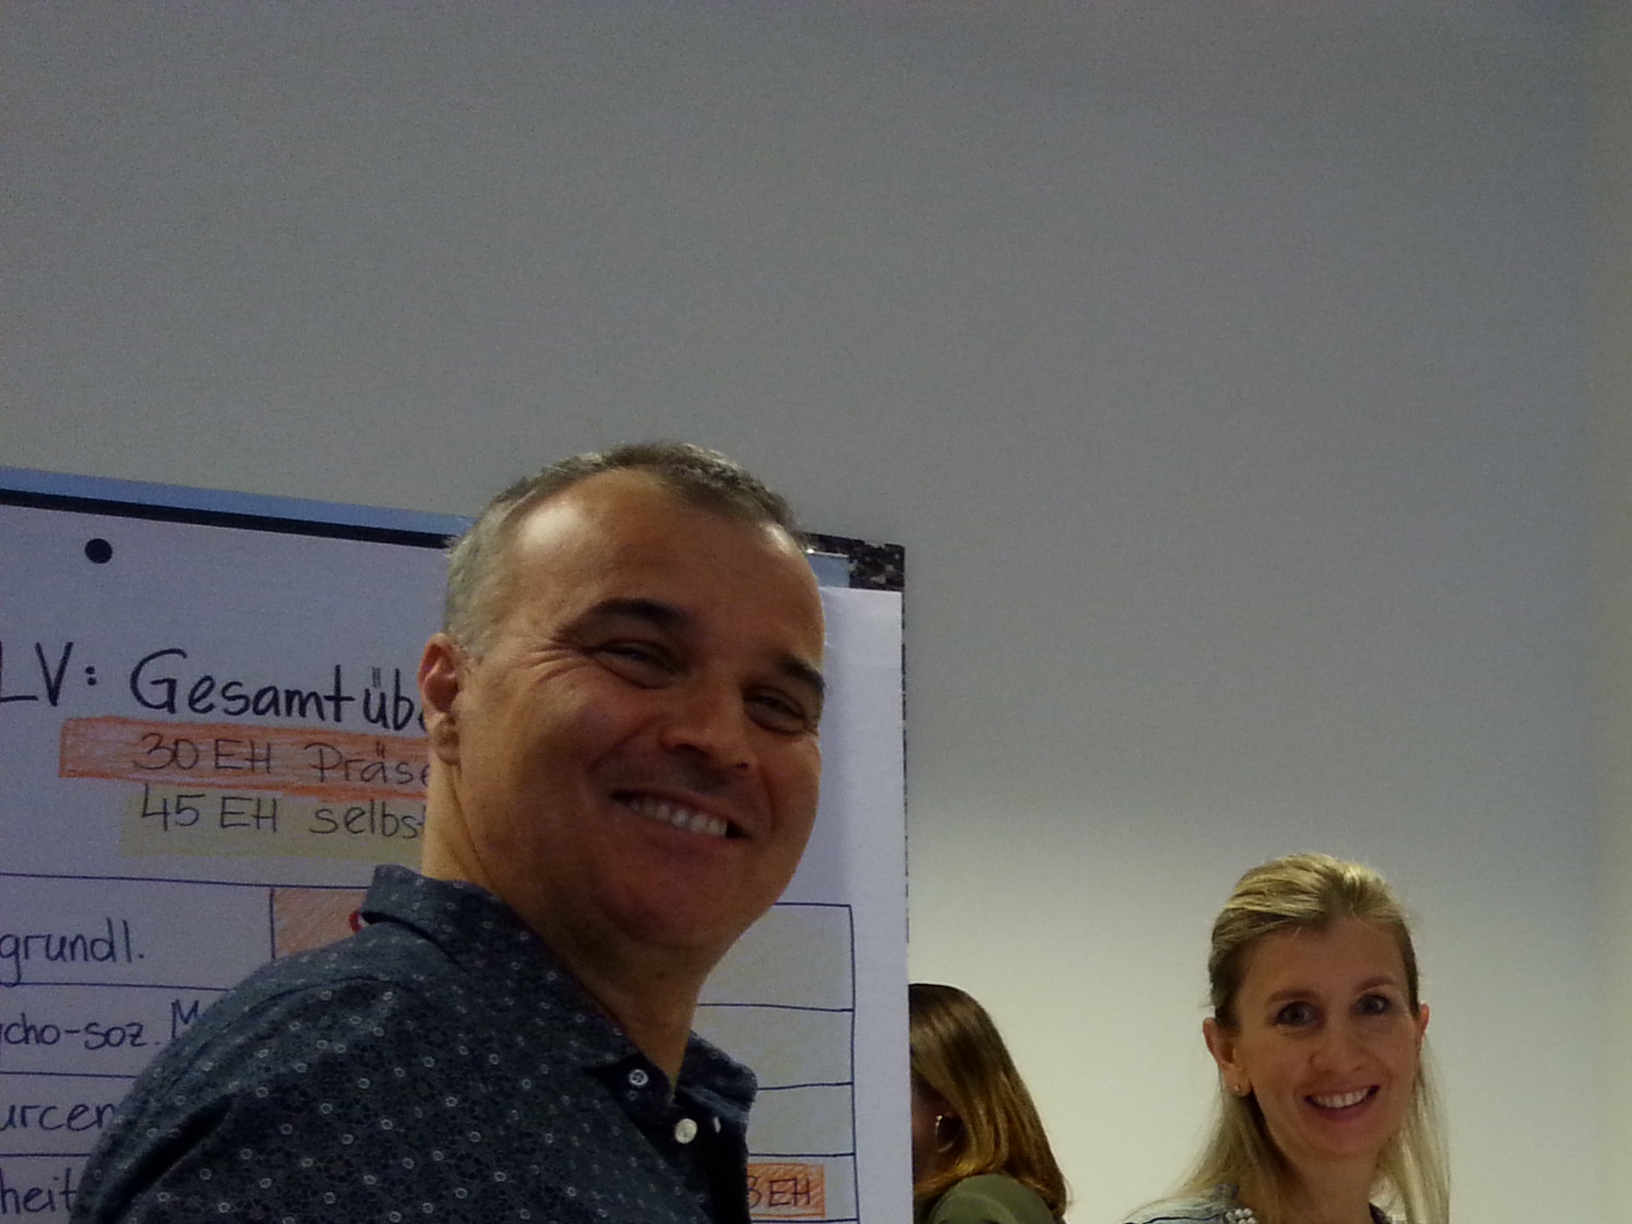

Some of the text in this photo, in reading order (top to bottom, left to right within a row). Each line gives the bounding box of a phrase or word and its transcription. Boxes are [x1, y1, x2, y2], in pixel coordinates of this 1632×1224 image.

[132, 732, 199, 771] 30
[214, 738, 271, 774] EH
[141, 783, 204, 830] 45
[219, 797, 278, 832] EH
[768, 1177, 811, 1208] EH
